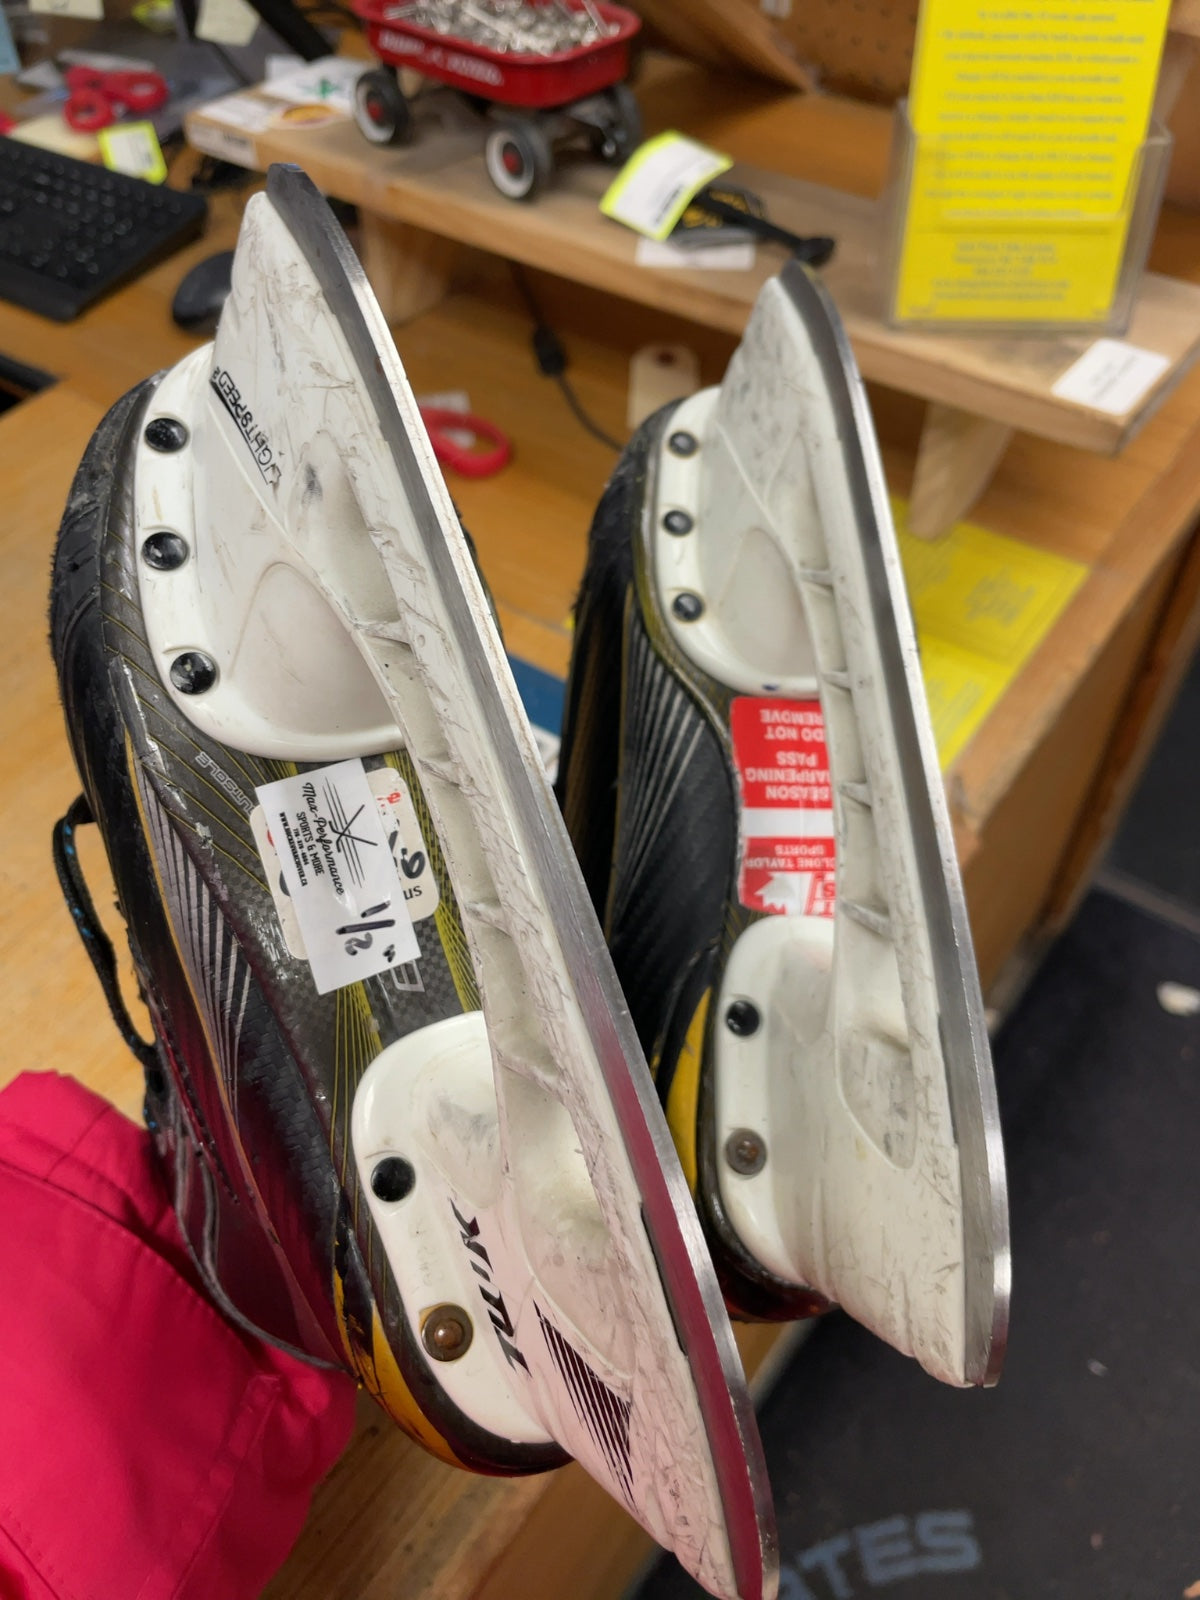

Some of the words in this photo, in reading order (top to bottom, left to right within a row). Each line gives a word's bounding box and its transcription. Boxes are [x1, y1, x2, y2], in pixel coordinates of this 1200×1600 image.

[760, 709, 824, 726] REMOVE
[763, 724, 799, 741] NOT
[800, 727, 826, 742] DO
[776, 750, 818, 767] PASS
[764, 784, 831, 801] SEASON
[295, 810, 315, 844] SPORTS
[309, 851, 326, 877] MORE
[301, 781, 345, 896] Max-Performance
[774, 843, 826, 858] SPORTS
